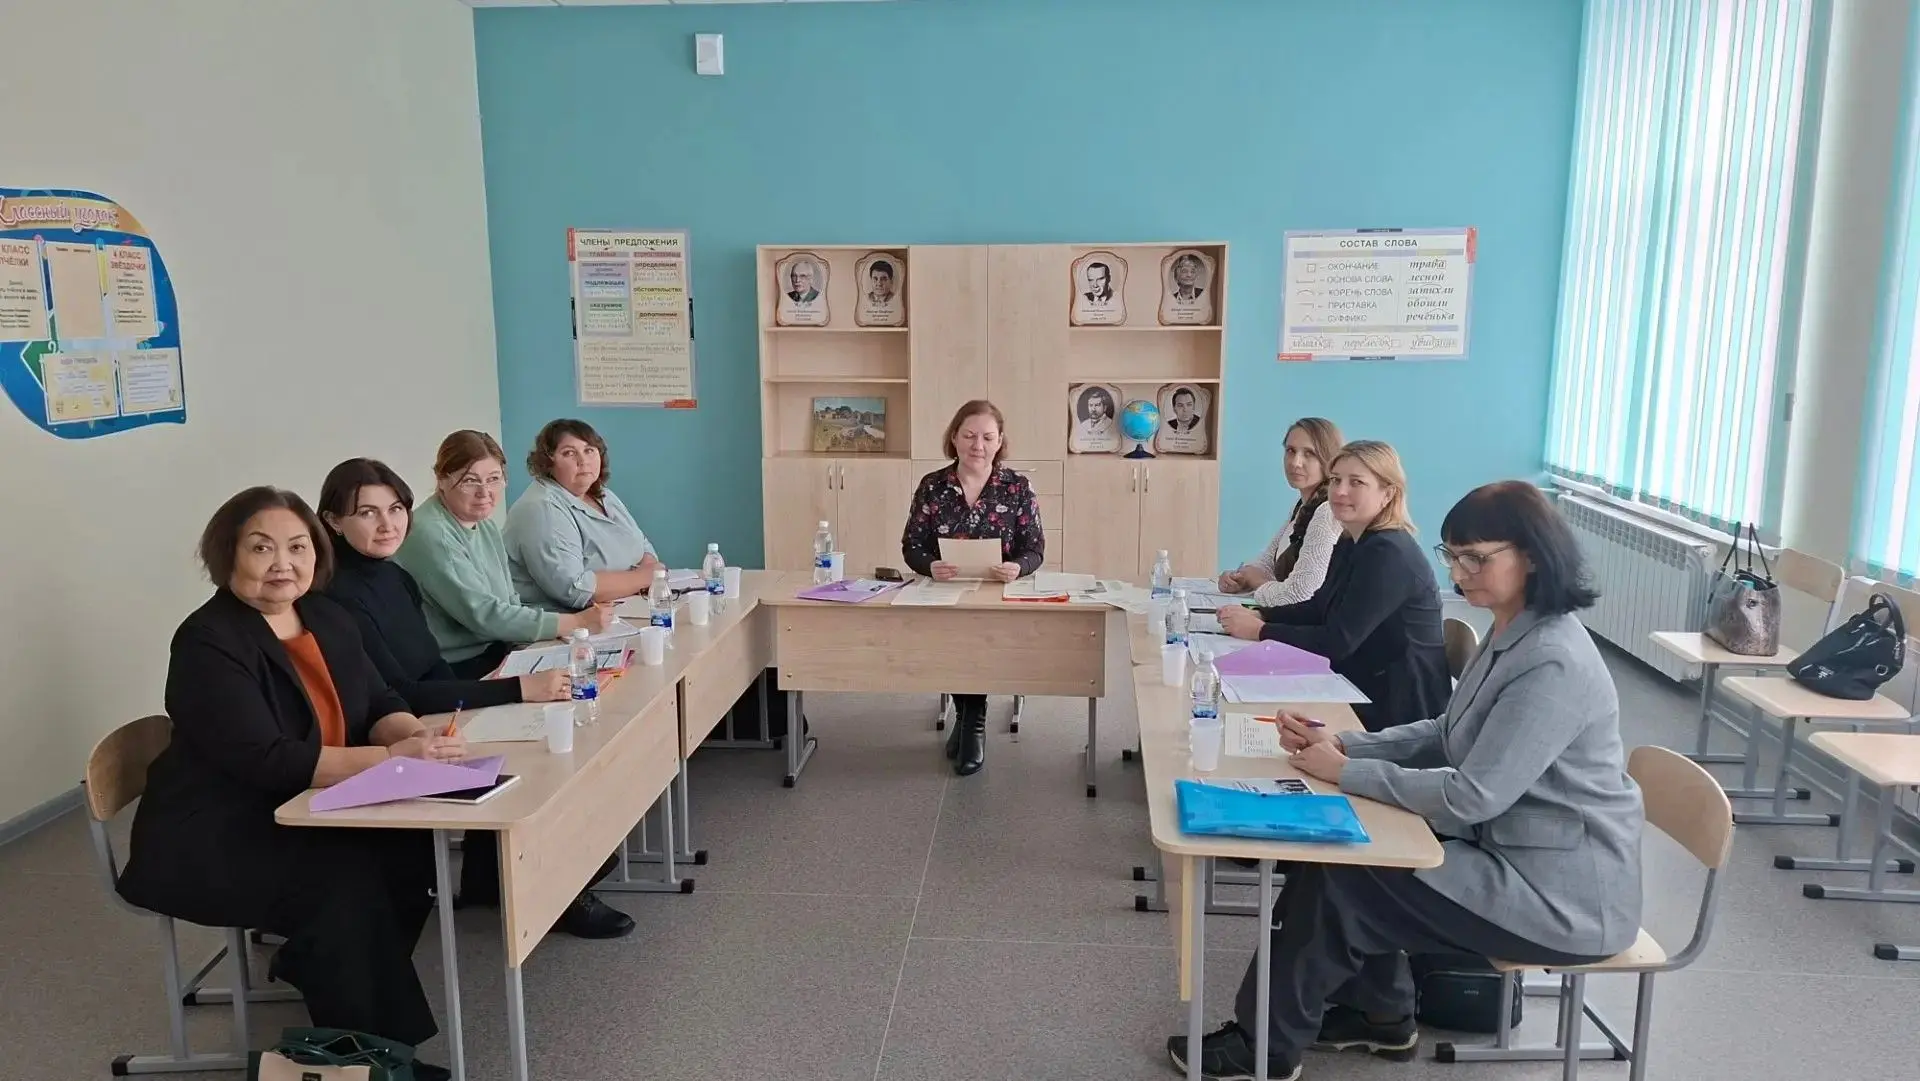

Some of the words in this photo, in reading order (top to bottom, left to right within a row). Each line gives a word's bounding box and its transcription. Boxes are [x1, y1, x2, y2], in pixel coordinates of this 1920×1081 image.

[580, 238, 611, 247] ЧЛЕНЫ
[614, 238, 679, 247] ПРЕДЛОЖЕНИЯ
[1339, 240, 1379, 248] СОСТАВ
[1384, 239, 1418, 247] СЛОВА
[2, 244, 30, 255] КЛАСС
[1327, 262, 1380, 271] ОКОНЧАНИЕ
[1409, 259, 1445, 271] трава
[1326, 275, 1363, 284] ОСНОВА
[1364, 274, 1394, 283] СЛОВА
[1410, 273, 1446, 282] лесной
[1328, 288, 1362, 297] КОРЕНЬ
[1364, 288, 1394, 296] СЛОВА
[1408, 287, 1454, 295] затихли
[1327, 301, 1378, 309] ПРИСТАВКА
[1407, 299, 1448, 307] обошли
[1327, 314, 1368, 323] СУФФИКС
